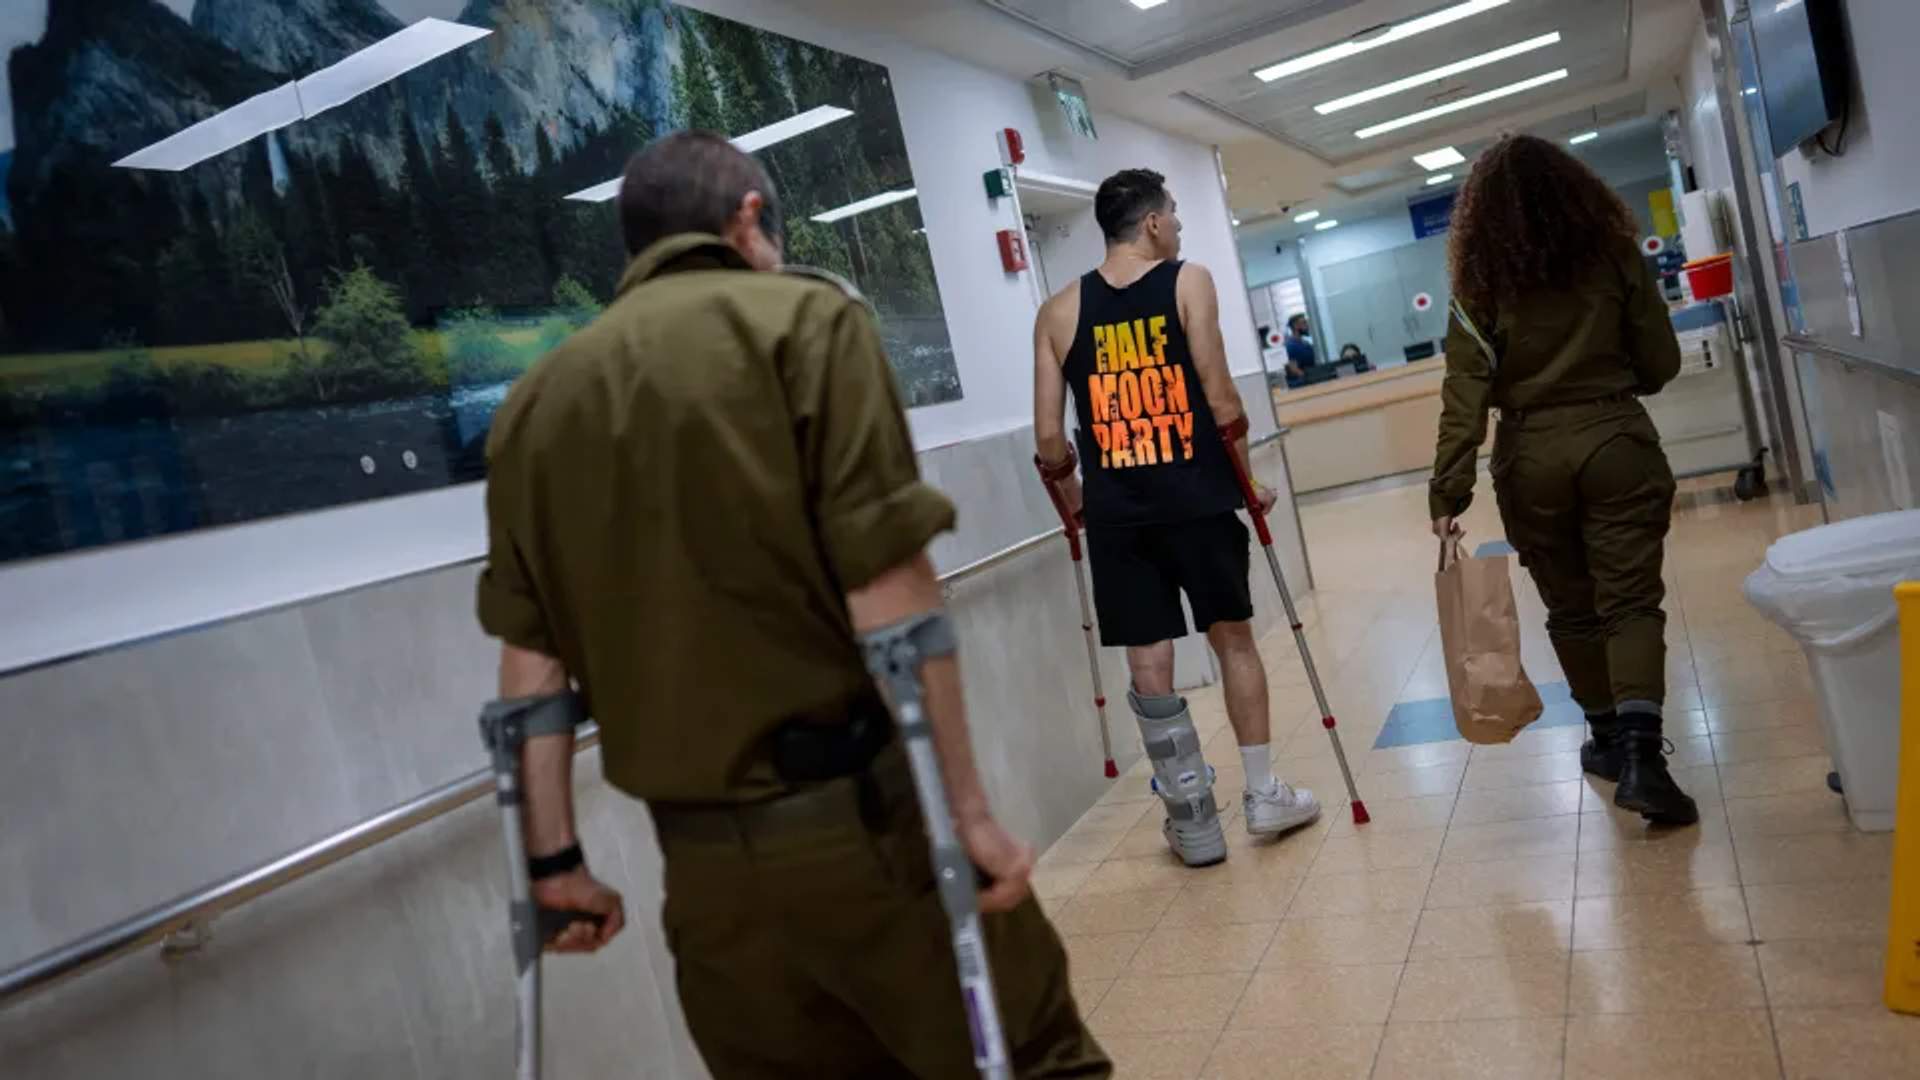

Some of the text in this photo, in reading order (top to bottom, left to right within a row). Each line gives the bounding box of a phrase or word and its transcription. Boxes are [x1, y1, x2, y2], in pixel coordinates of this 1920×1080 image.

[1093, 315, 1168, 373] HALF
[1088, 364, 1189, 422] MOON
[1091, 412, 1193, 468] PARTY
